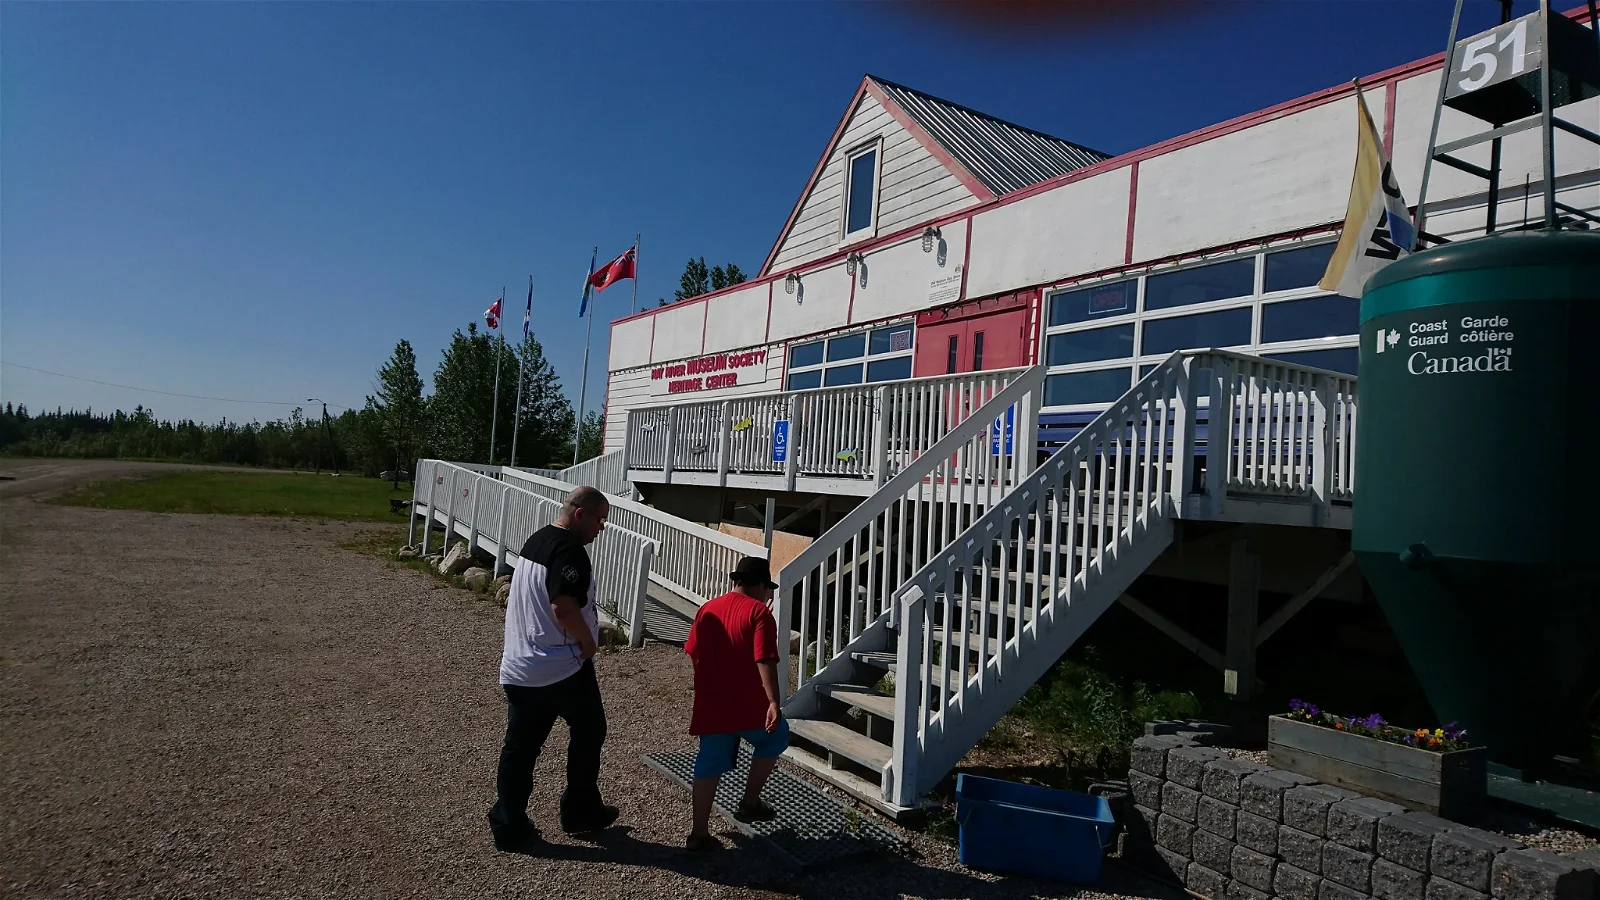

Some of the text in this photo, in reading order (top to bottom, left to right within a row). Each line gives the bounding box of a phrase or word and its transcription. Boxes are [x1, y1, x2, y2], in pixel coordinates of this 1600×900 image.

[1459, 19, 1527, 91] 51
[1409, 320, 1448, 334] Coast
[1461, 315, 1509, 329] Garde
[1408, 333, 1449, 347] Guard
[1459, 330, 1515, 343] côtière
[665, 364, 686, 379] RIVER
[687, 353, 728, 376] MUSEUM
[728, 350, 766, 369] SOCIETY
[1407, 347, 1513, 375] Canada
[668, 372, 738, 393] HERITAGE CENTER
